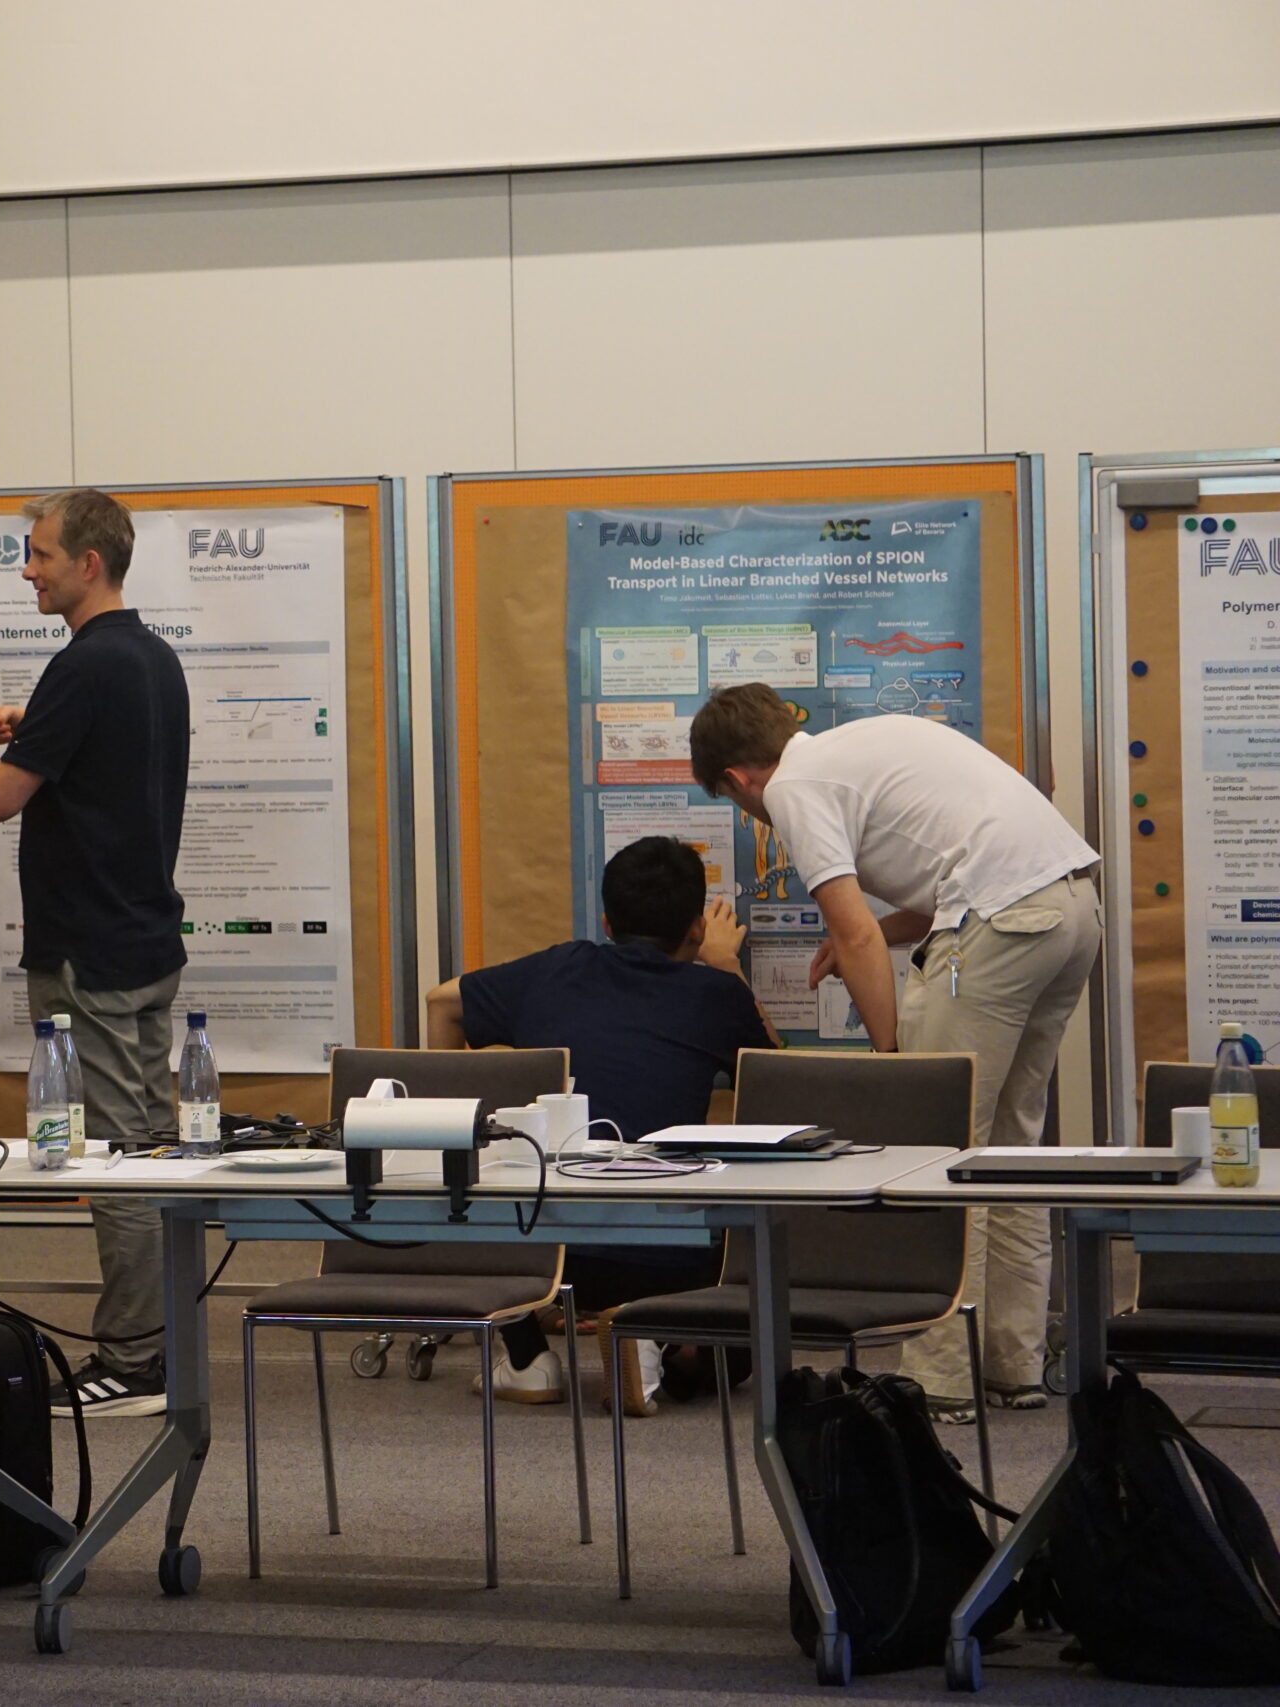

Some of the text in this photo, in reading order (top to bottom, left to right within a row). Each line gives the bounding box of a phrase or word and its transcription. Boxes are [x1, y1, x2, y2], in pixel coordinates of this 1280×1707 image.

[599, 522, 663, 547] FAU
[678, 525, 705, 546] idc
[818, 519, 872, 542] ASC
[188, 527, 265, 560] FAU
[189, 562, 310, 573] Friedrich-Alexander-Universität
[629, 550, 925, 571] Model-Based Characterization of SPION
[190, 572, 265, 583] Technische Fakultät
[607, 569, 949, 592] Transport in Linear Branched Vessel Networks
[51, 625, 67, 638] of
[145, 622, 193, 639] Things
[1205, 666, 1250, 674] Motivation
[1252, 665, 1268, 673] and
[1211, 902, 1238, 911] Project
[1211, 934, 1233, 943] What
[1234, 935, 1249, 943] are
